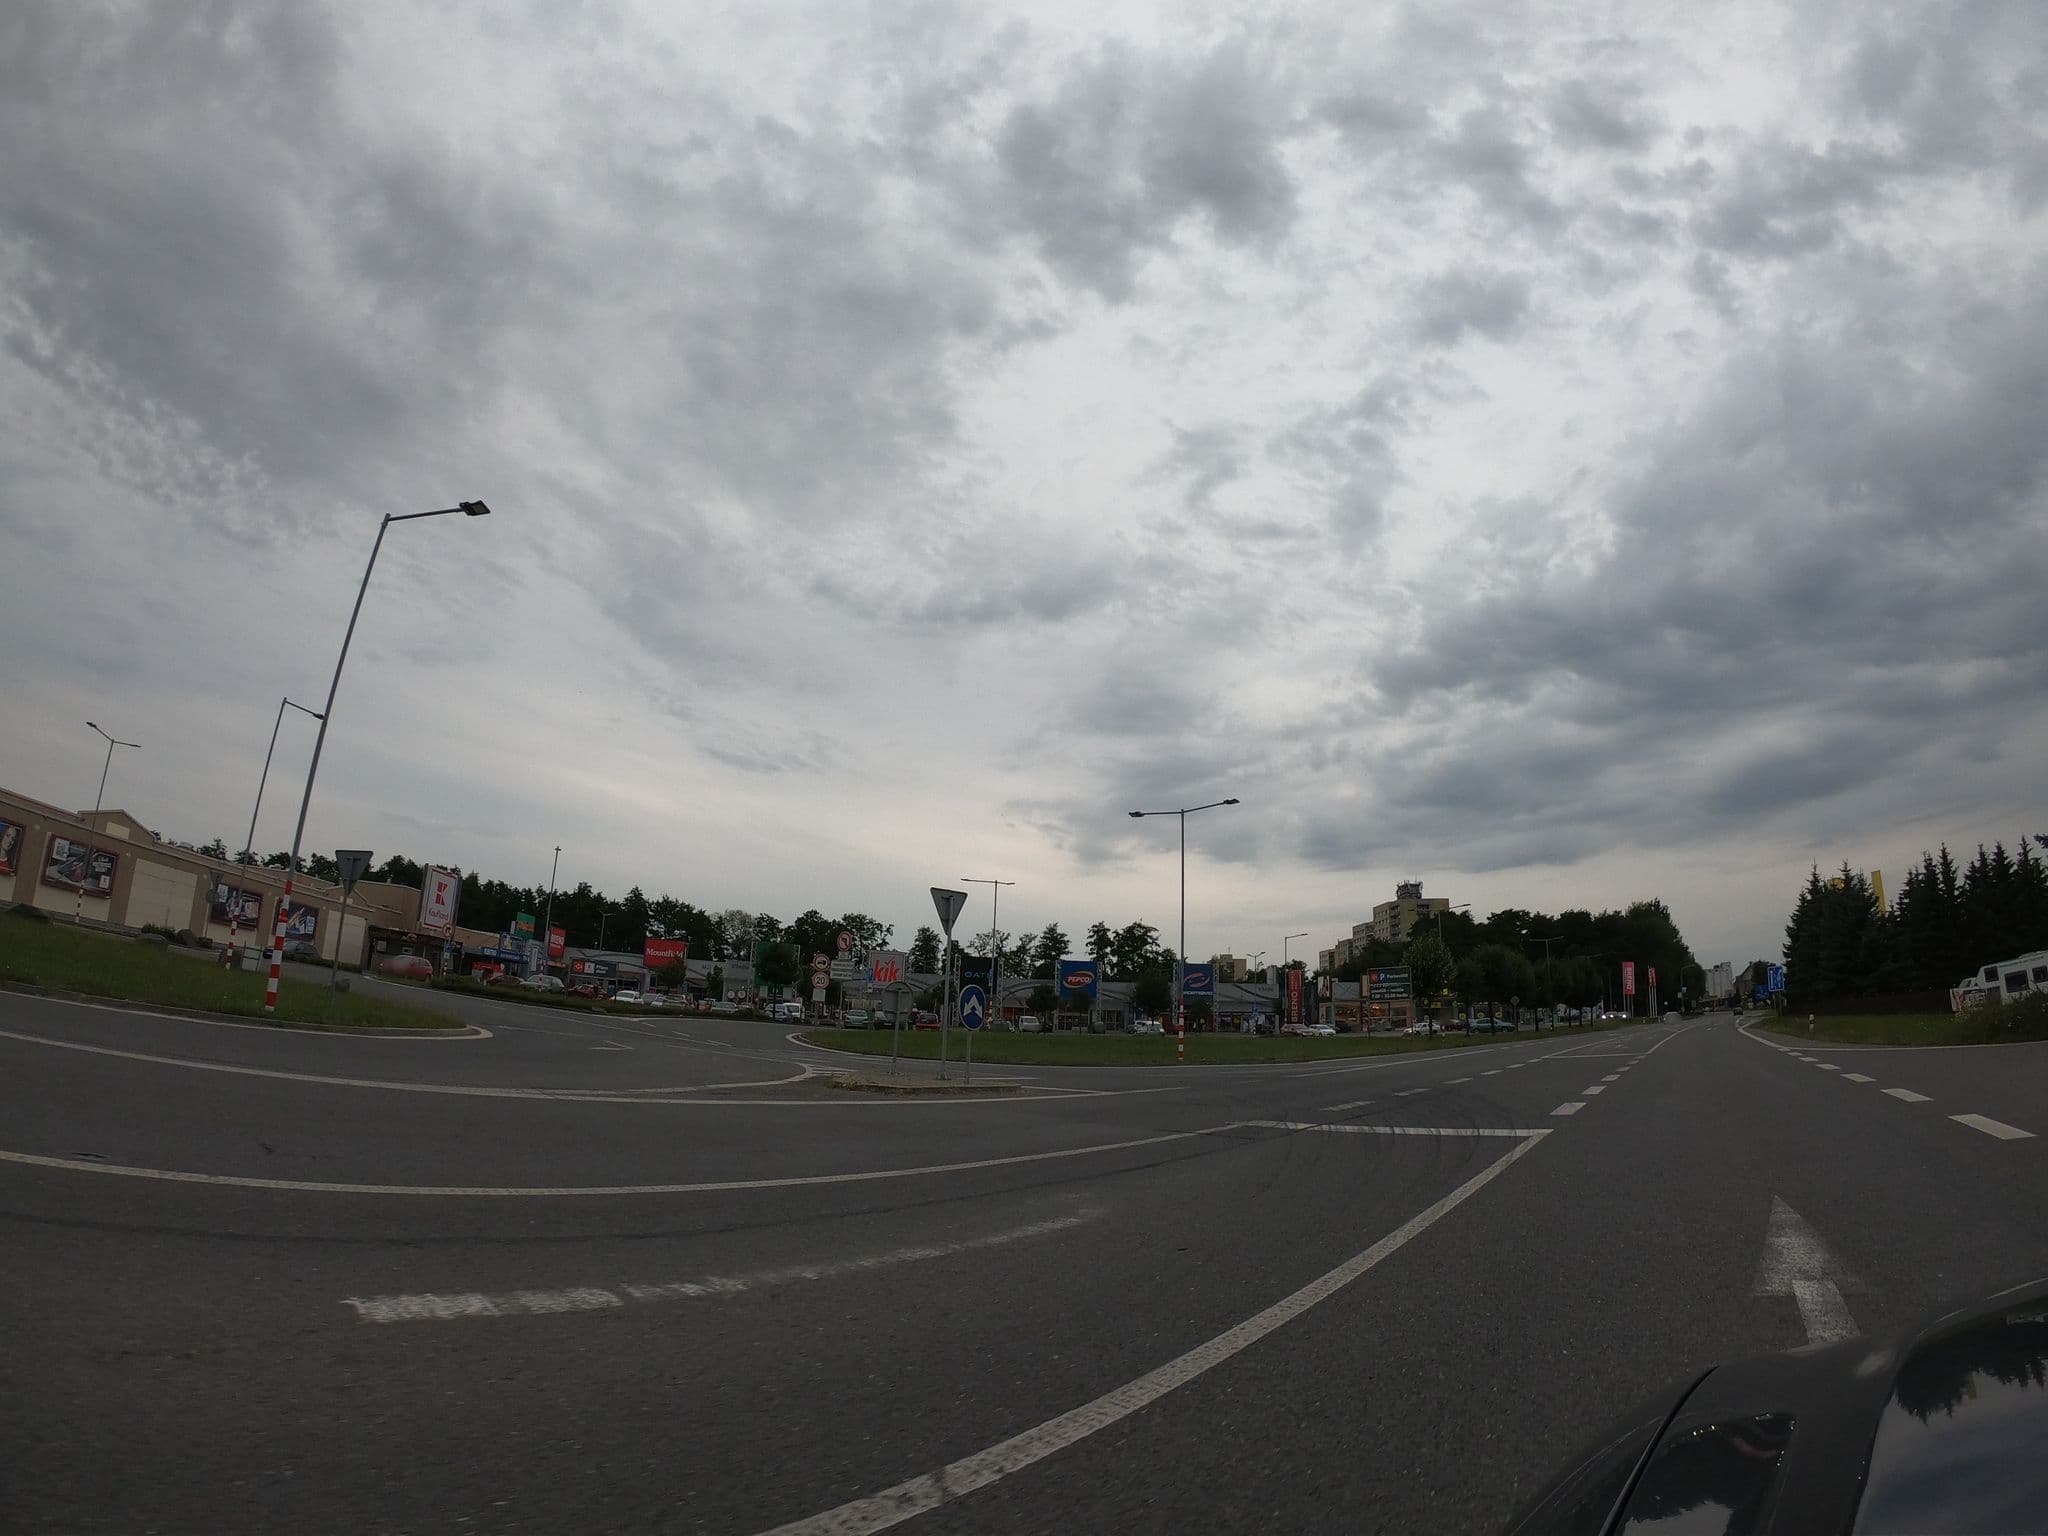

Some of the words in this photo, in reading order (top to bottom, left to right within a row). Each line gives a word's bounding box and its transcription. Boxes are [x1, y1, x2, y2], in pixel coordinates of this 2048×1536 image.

[645, 948, 684, 959] Mountfield
[815, 976, 825, 985] 20
[1067, 976, 1091, 984] PEPCO
